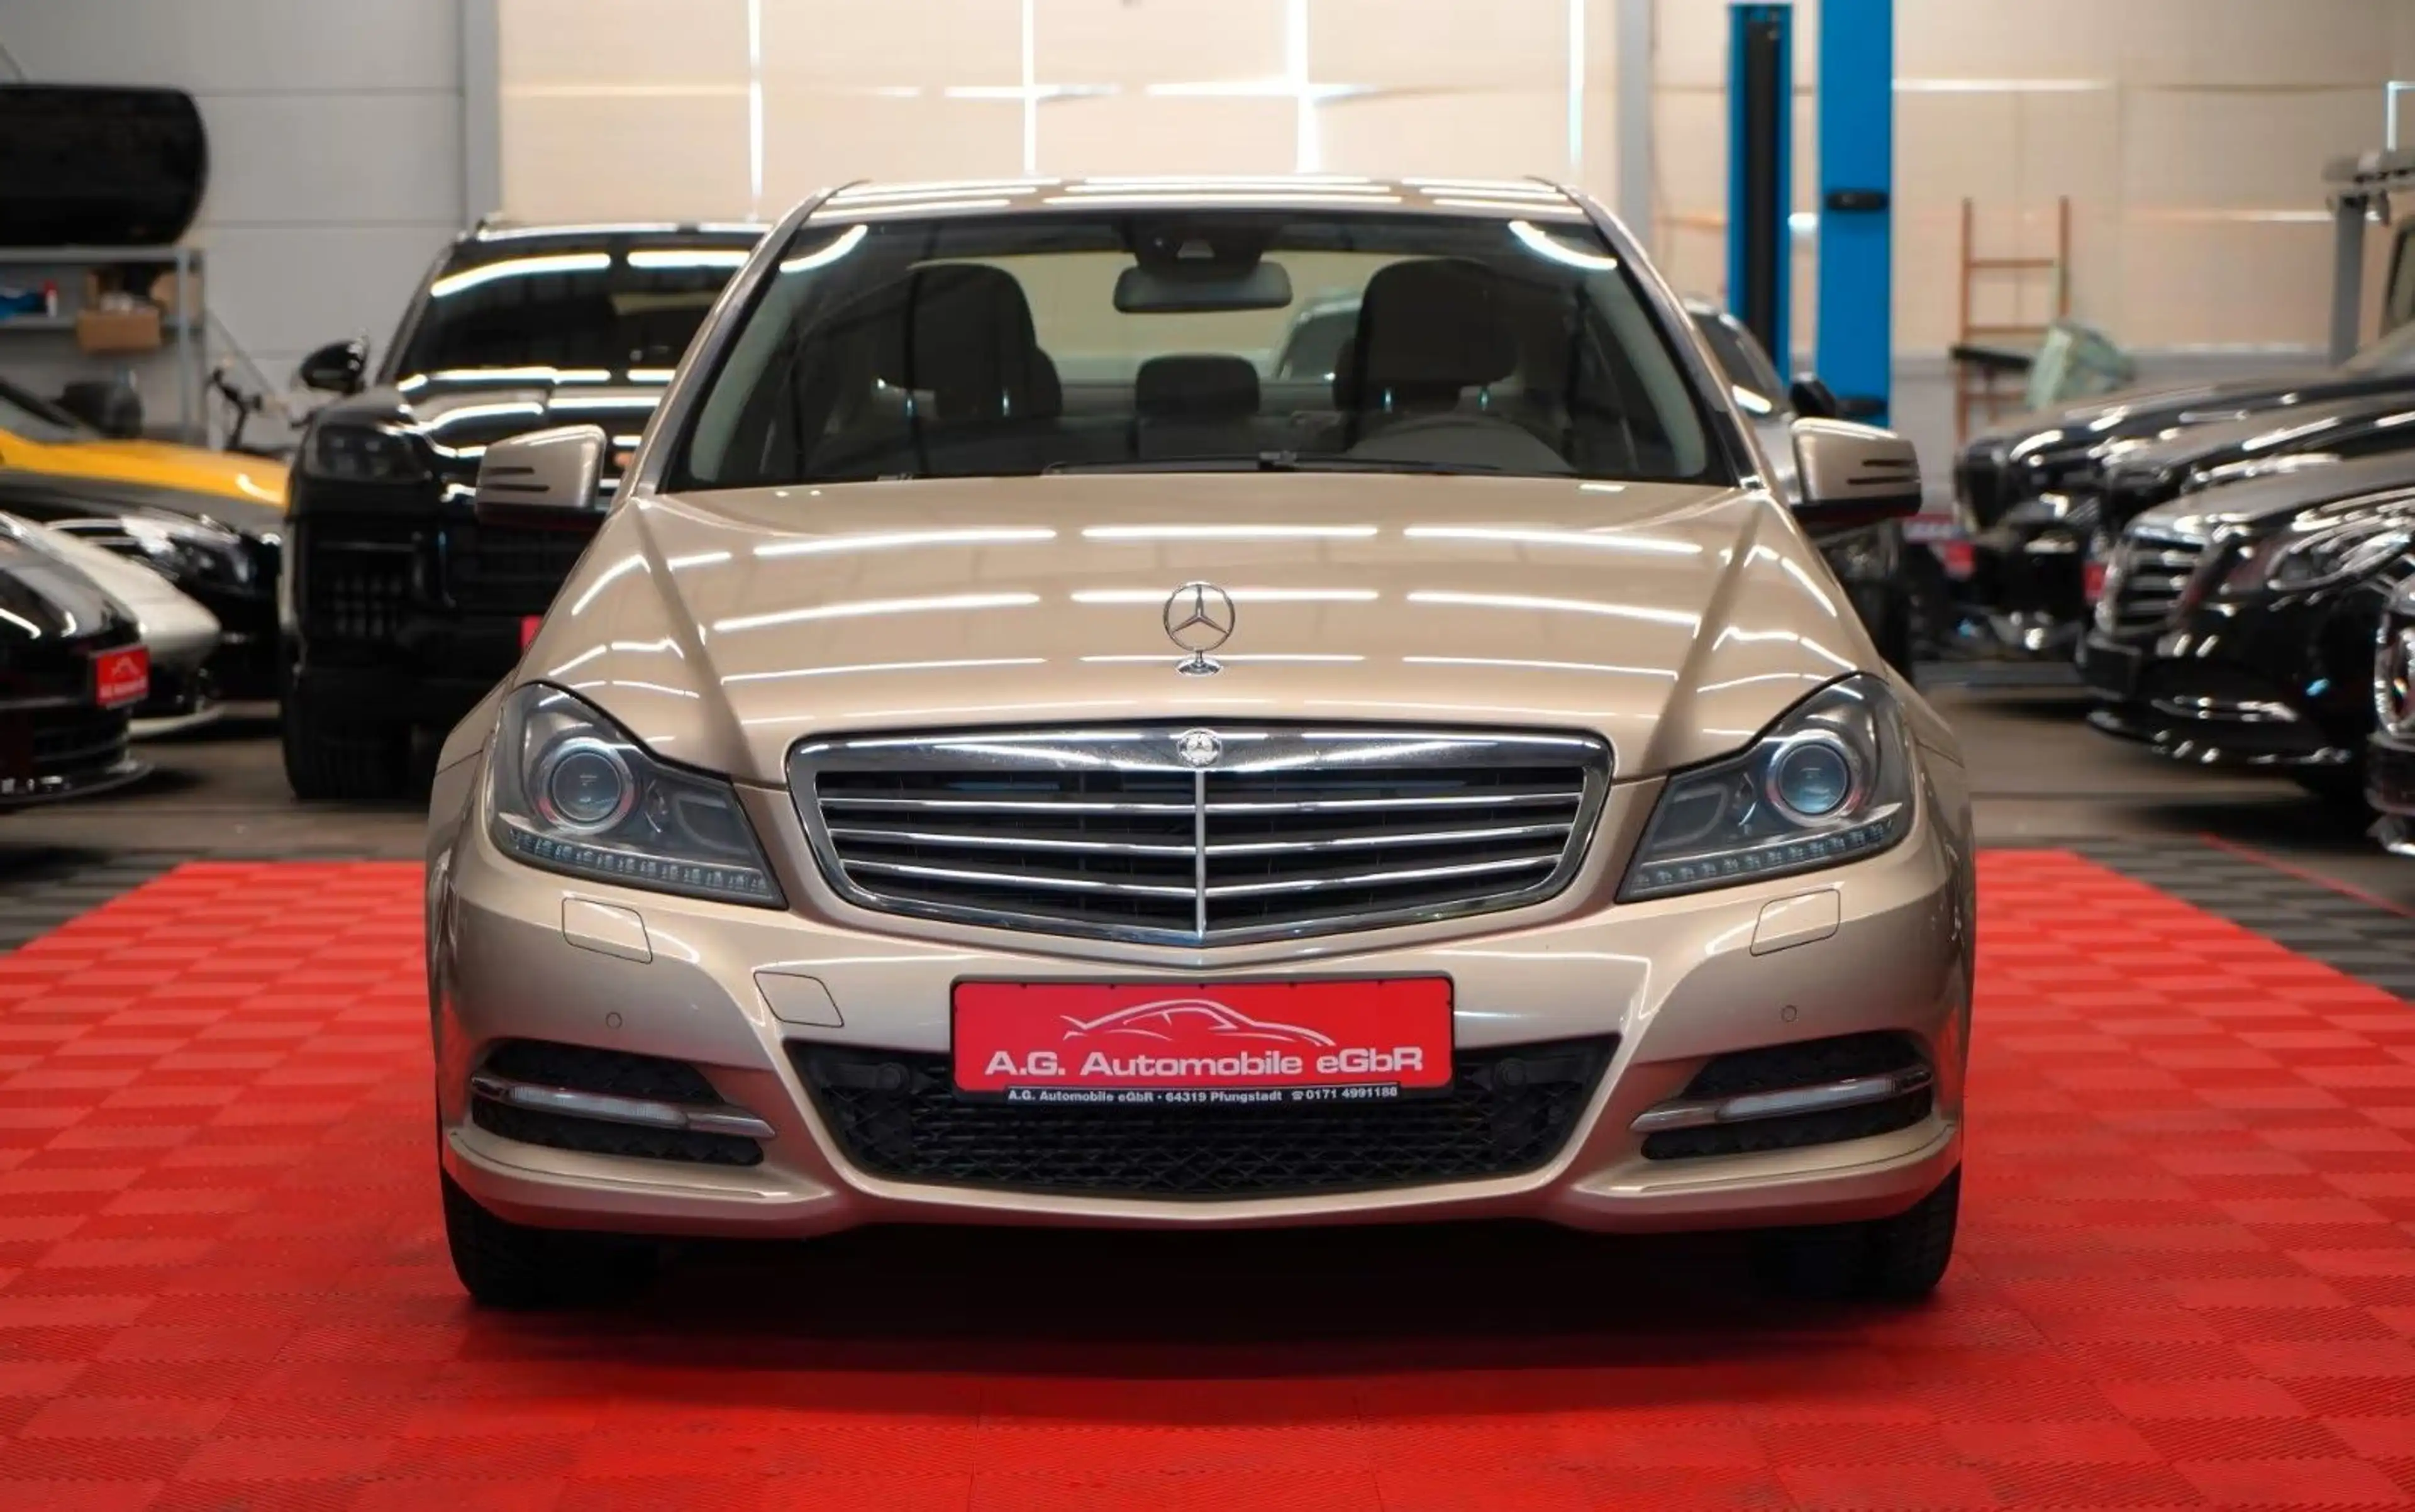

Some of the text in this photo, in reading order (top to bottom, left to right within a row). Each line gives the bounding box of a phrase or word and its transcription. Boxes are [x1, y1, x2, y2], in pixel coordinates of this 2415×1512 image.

[985, 1047, 1423, 1076] A.G. Automobile eGbR
[1008, 1089, 1036, 1100] A.G.
[1040, 1091, 1114, 1101] Automobile
[1118, 1091, 1153, 1102] eGbR
[1165, 1091, 1207, 1102] 64319
[1210, 1091, 1282, 1103] Pfungstadt
[1306, 1089, 1337, 1099] 0171
